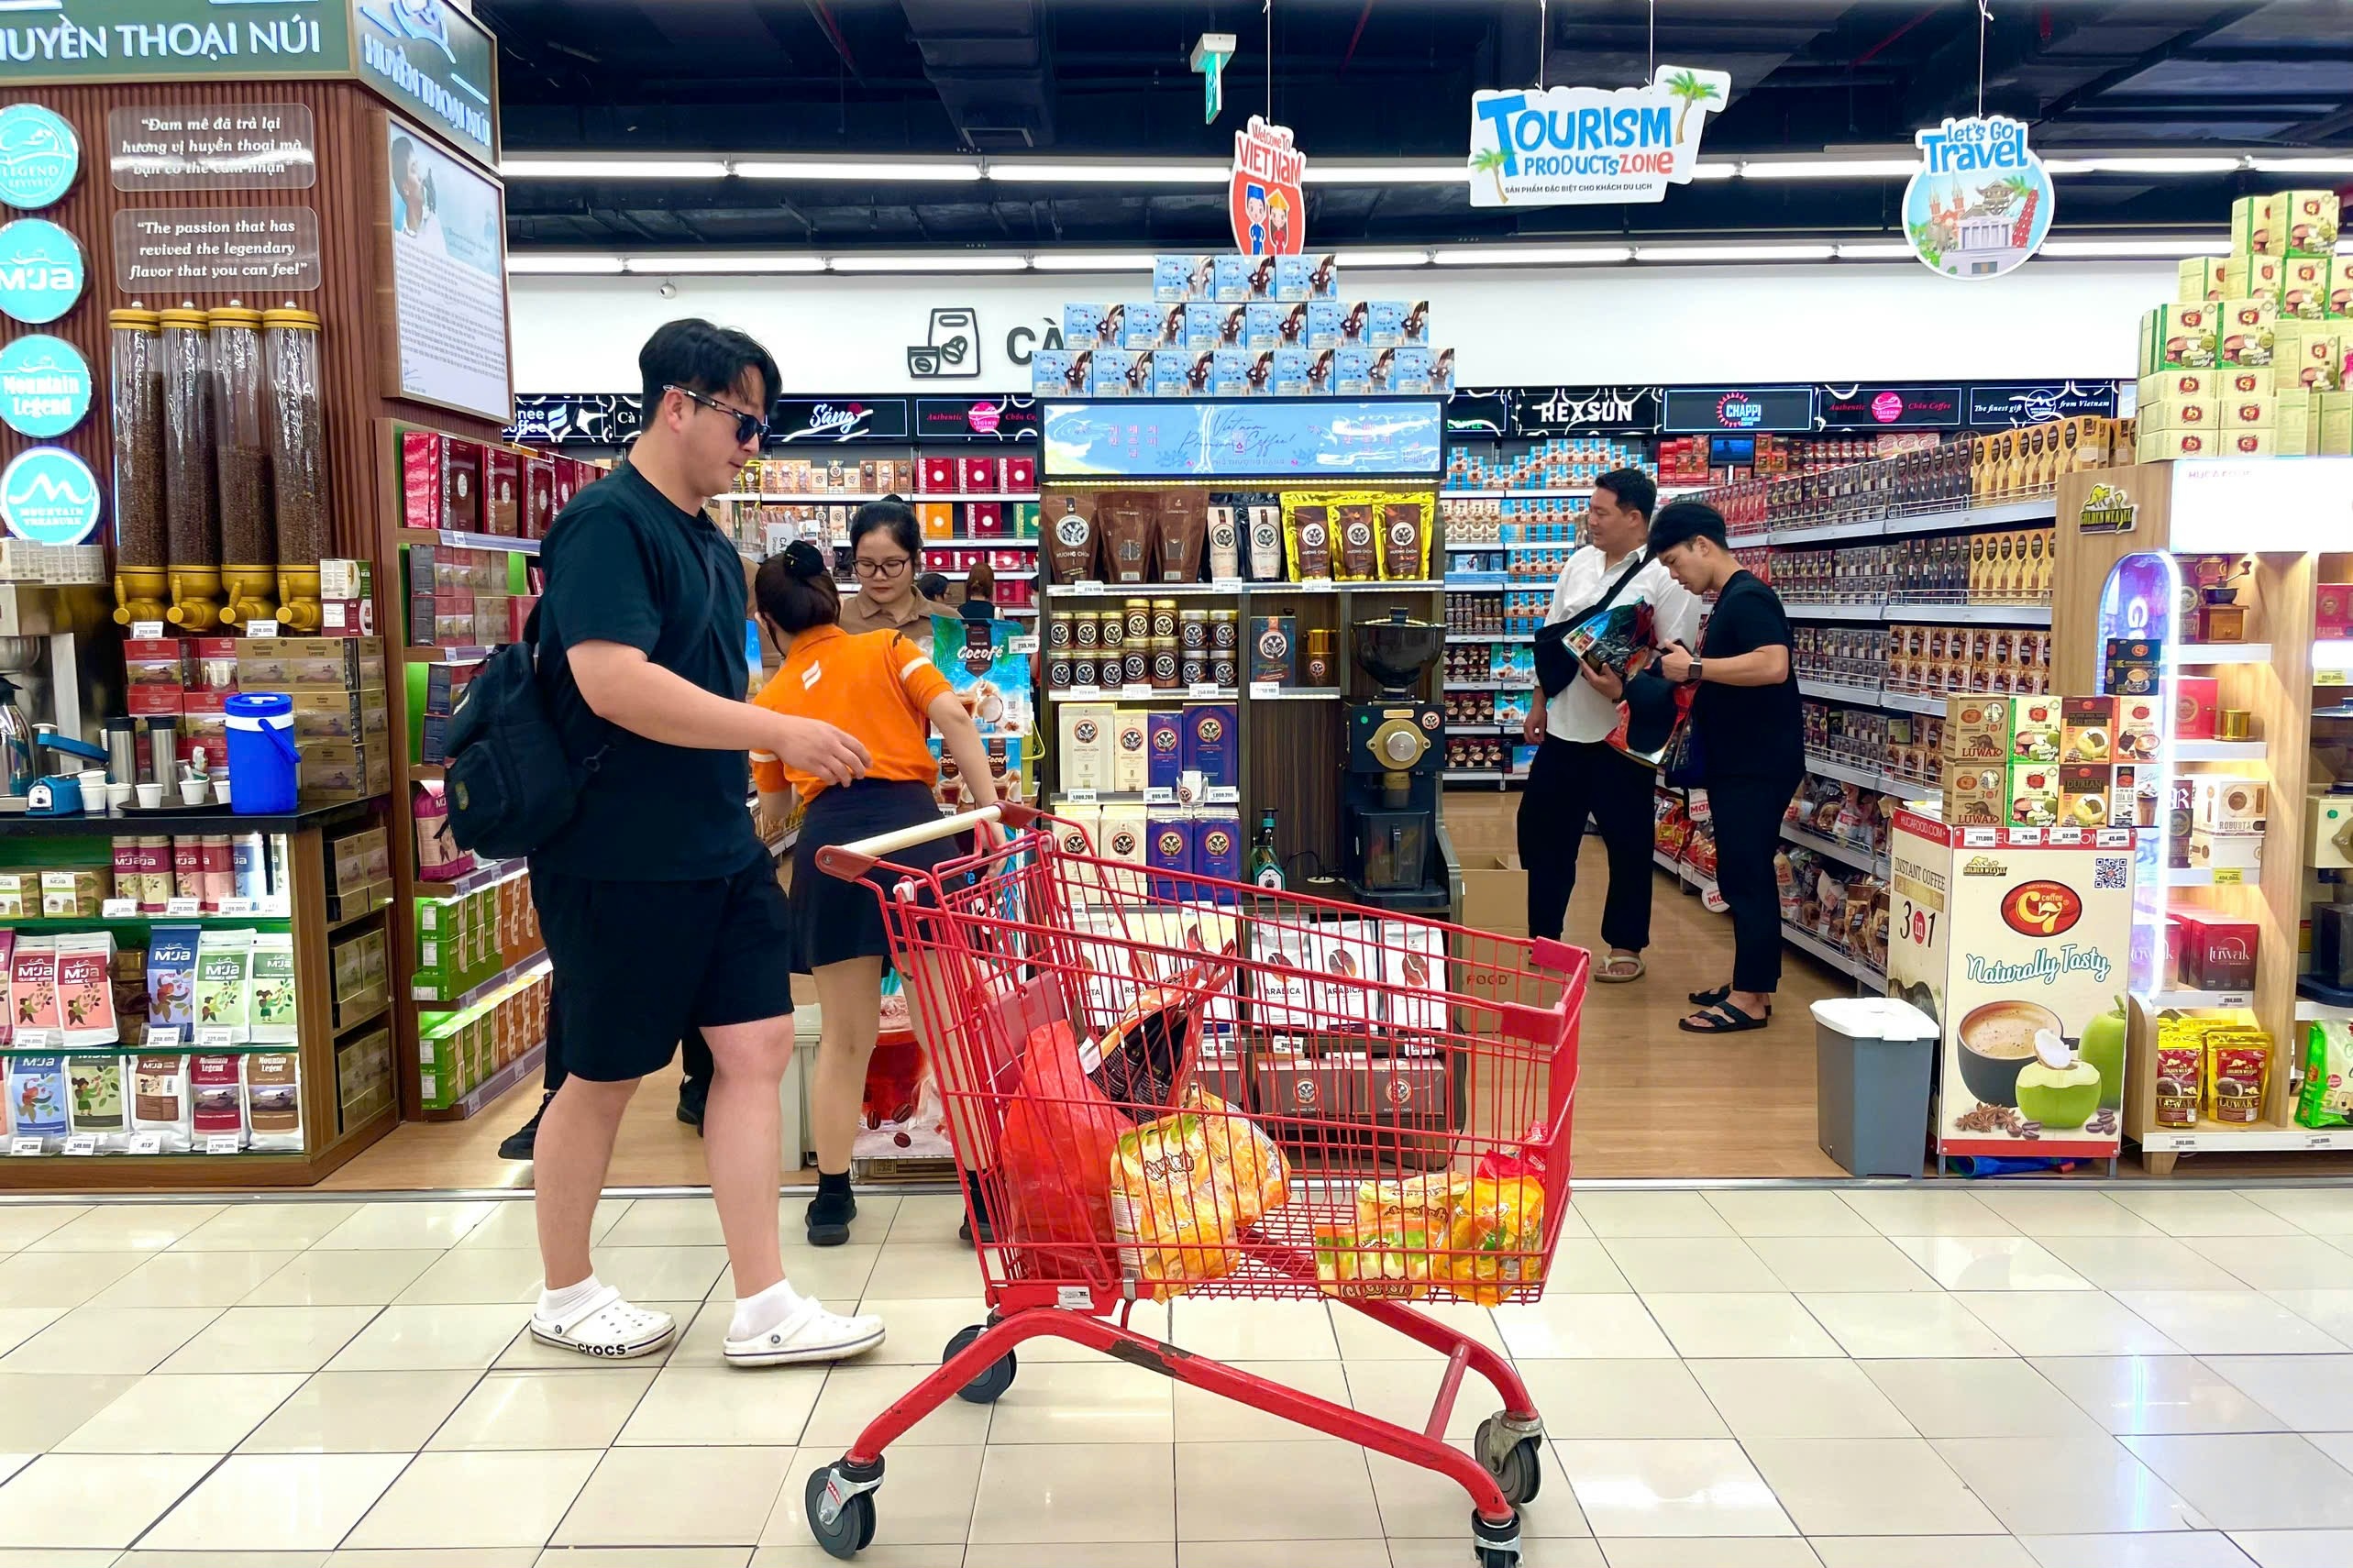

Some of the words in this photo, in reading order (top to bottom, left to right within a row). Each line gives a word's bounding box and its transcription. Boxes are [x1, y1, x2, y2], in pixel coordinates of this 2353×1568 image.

[115, 22, 238, 61] THOẠI
[249, 14, 320, 54] NÚI
[187, 117, 209, 130] mê
[213, 116, 231, 130] đã
[262, 116, 281, 132] lại
[1990, 121, 2015, 141] Go
[1476, 94, 1673, 178] TOURISM
[122, 140, 167, 155] hương
[171, 140, 184, 155] vị
[189, 137, 232, 155] huyền
[237, 139, 275, 154] thoại
[1922, 128, 2028, 173] Travel
[1561, 183, 1577, 193] BIỆT
[1578, 183, 1595, 192] CHO
[1595, 182, 1622, 192] KHÁCH
[1623, 182, 1634, 191] DU
[1635, 182, 1652, 193] LỊCH
[175, 221, 230, 237] passion
[235, 220, 265, 233] that
[270, 220, 295, 231] has
[139, 243, 192, 256] revived
[196, 242, 220, 255] the
[224, 241, 295, 256] legendary
[129, 264, 173, 281] flavor
[178, 264, 207, 277] that
[211, 266, 238, 280] you
[242, 265, 268, 275] can
[3, 374, 81, 395] Mountain
[13, 396, 72, 418] Legend
[1541, 403, 1633, 423] REXSUN
[1828, 403, 1866, 412] Authentic
[1928, 402, 1952, 411] Coffee
[1974, 404, 1987, 413] The
[1987, 403, 2010, 414] finest
[2060, 400, 2078, 410] from
[2079, 399, 2110, 409] Vietnam
[810, 403, 859, 435] Sáng
[2080, 510, 2104, 526] GOLDEN
[957, 644, 1005, 661] Cocofé
[1962, 747, 2003, 757] LUWAK
[2066, 779, 2103, 789] DURIAN
[1958, 814, 1999, 824] LUWAK
[2218, 820, 2253, 831] ROBUSTA
[1895, 856, 1922, 881] INSTANT
[1922, 867, 1946, 891] COFFEE
[2040, 892, 2063, 902] coffee
[1899, 900, 1912, 940] 3
[1914, 914, 1924, 938] in
[1928, 911, 1937, 948] 1
[1966, 948, 2060, 985] Naturally
[2060, 944, 2111, 983] Tasty
[1265, 987, 1301, 997] ARABICA
[1327, 986, 1365, 996] ARABICA
[201, 1064, 224, 1073] Legend
[261, 1064, 283, 1072] Legend
[2218, 1098, 2253, 1110] LUWAK
[577, 1342, 626, 1356] crocs
